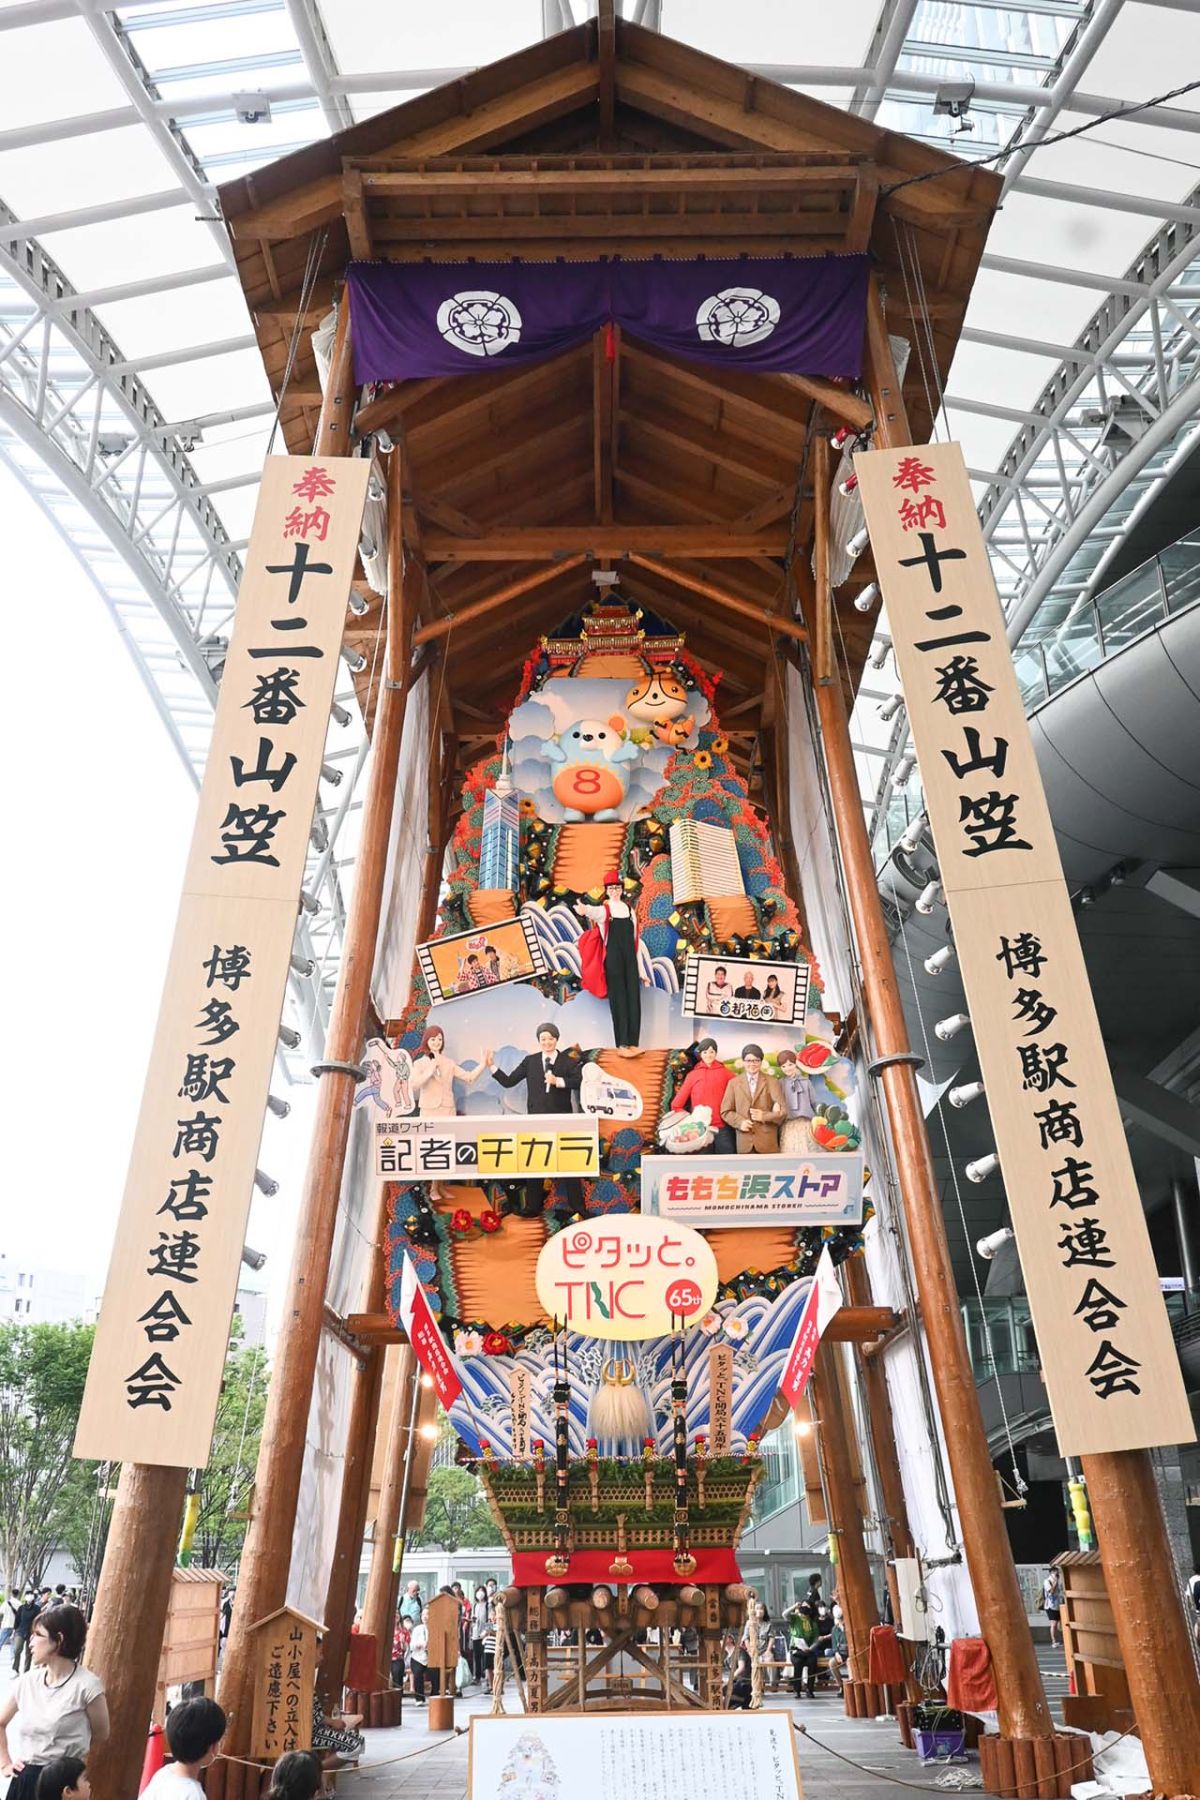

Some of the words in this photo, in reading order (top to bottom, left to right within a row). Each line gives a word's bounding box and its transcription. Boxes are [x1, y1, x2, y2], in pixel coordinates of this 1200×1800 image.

[282, 466, 336, 541] 奉納
[892, 457, 946, 532] 奉納
[211, 542, 333, 867] 十二番山笠
[898, 533, 1033, 857] 十二番山笠
[573, 769, 600, 794] 8
[376, 1122, 434, 1133] 報道ワイド
[380, 1137, 593, 1171] 記者のチカラ
[124, 945, 252, 1411] 博多駅商店連合会
[667, 1174, 841, 1201] ももち浜ストア
[995, 933, 1141, 1399] 博多駅商店連合会
[562, 1231, 695, 1268] ピタッと。
[554, 1280, 646, 1320] TNC
[265, 1645, 285, 1750] ご遠慮下さい
[283, 1627, 303, 1752] 山小屋への立入は
